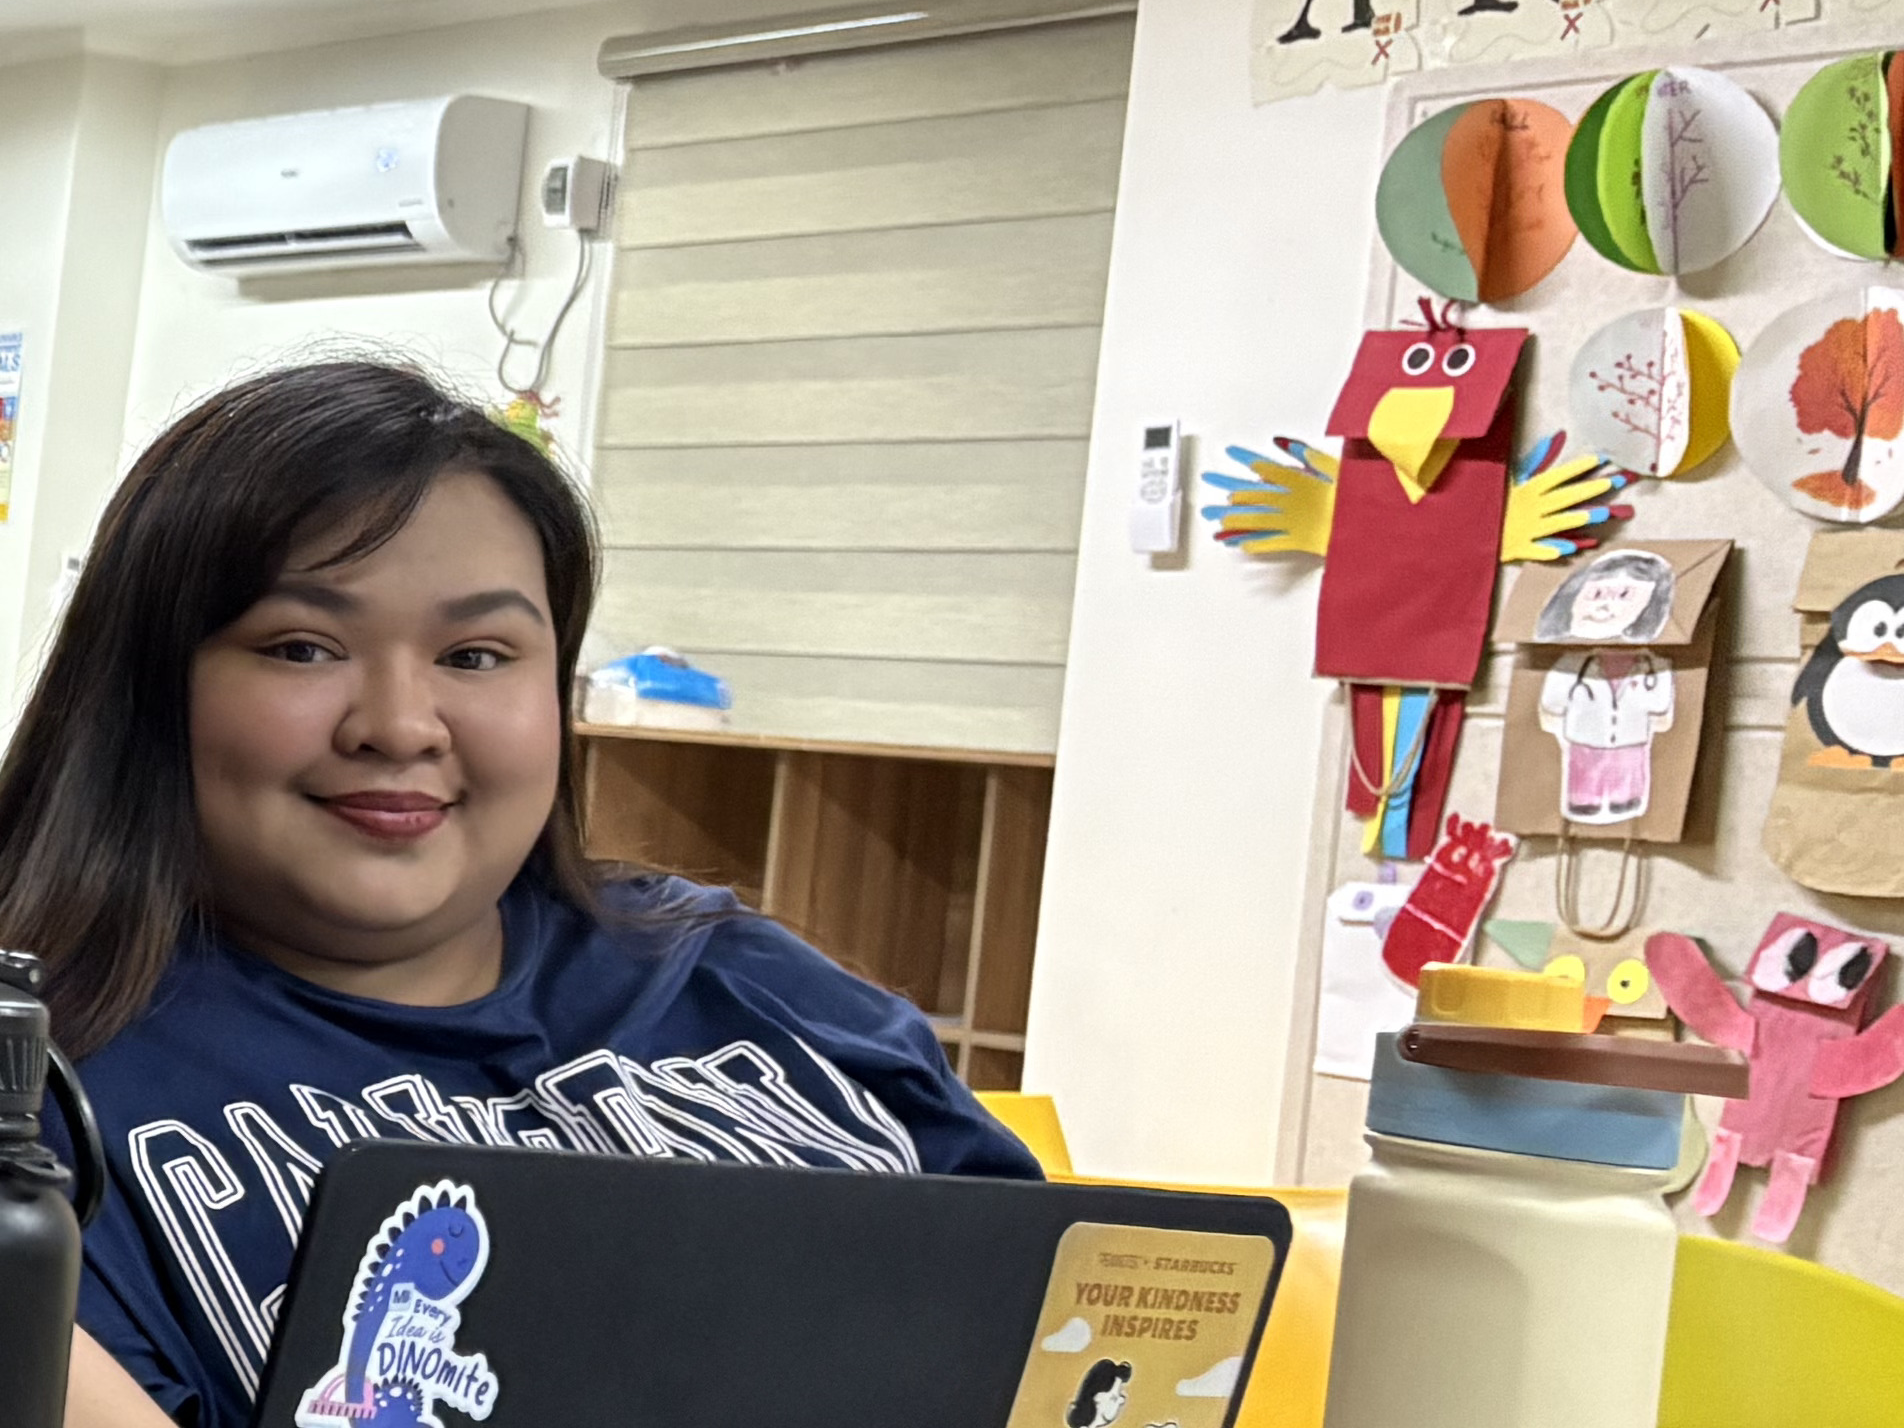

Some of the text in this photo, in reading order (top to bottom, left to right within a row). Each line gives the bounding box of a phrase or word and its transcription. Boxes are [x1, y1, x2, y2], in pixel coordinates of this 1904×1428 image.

[1074, 1281, 1242, 1315] YOUR KINDNESS
[413, 1298, 453, 1328] Every
[1099, 1313, 1200, 1342] INSPIRES
[385, 1315, 447, 1344] Idea is
